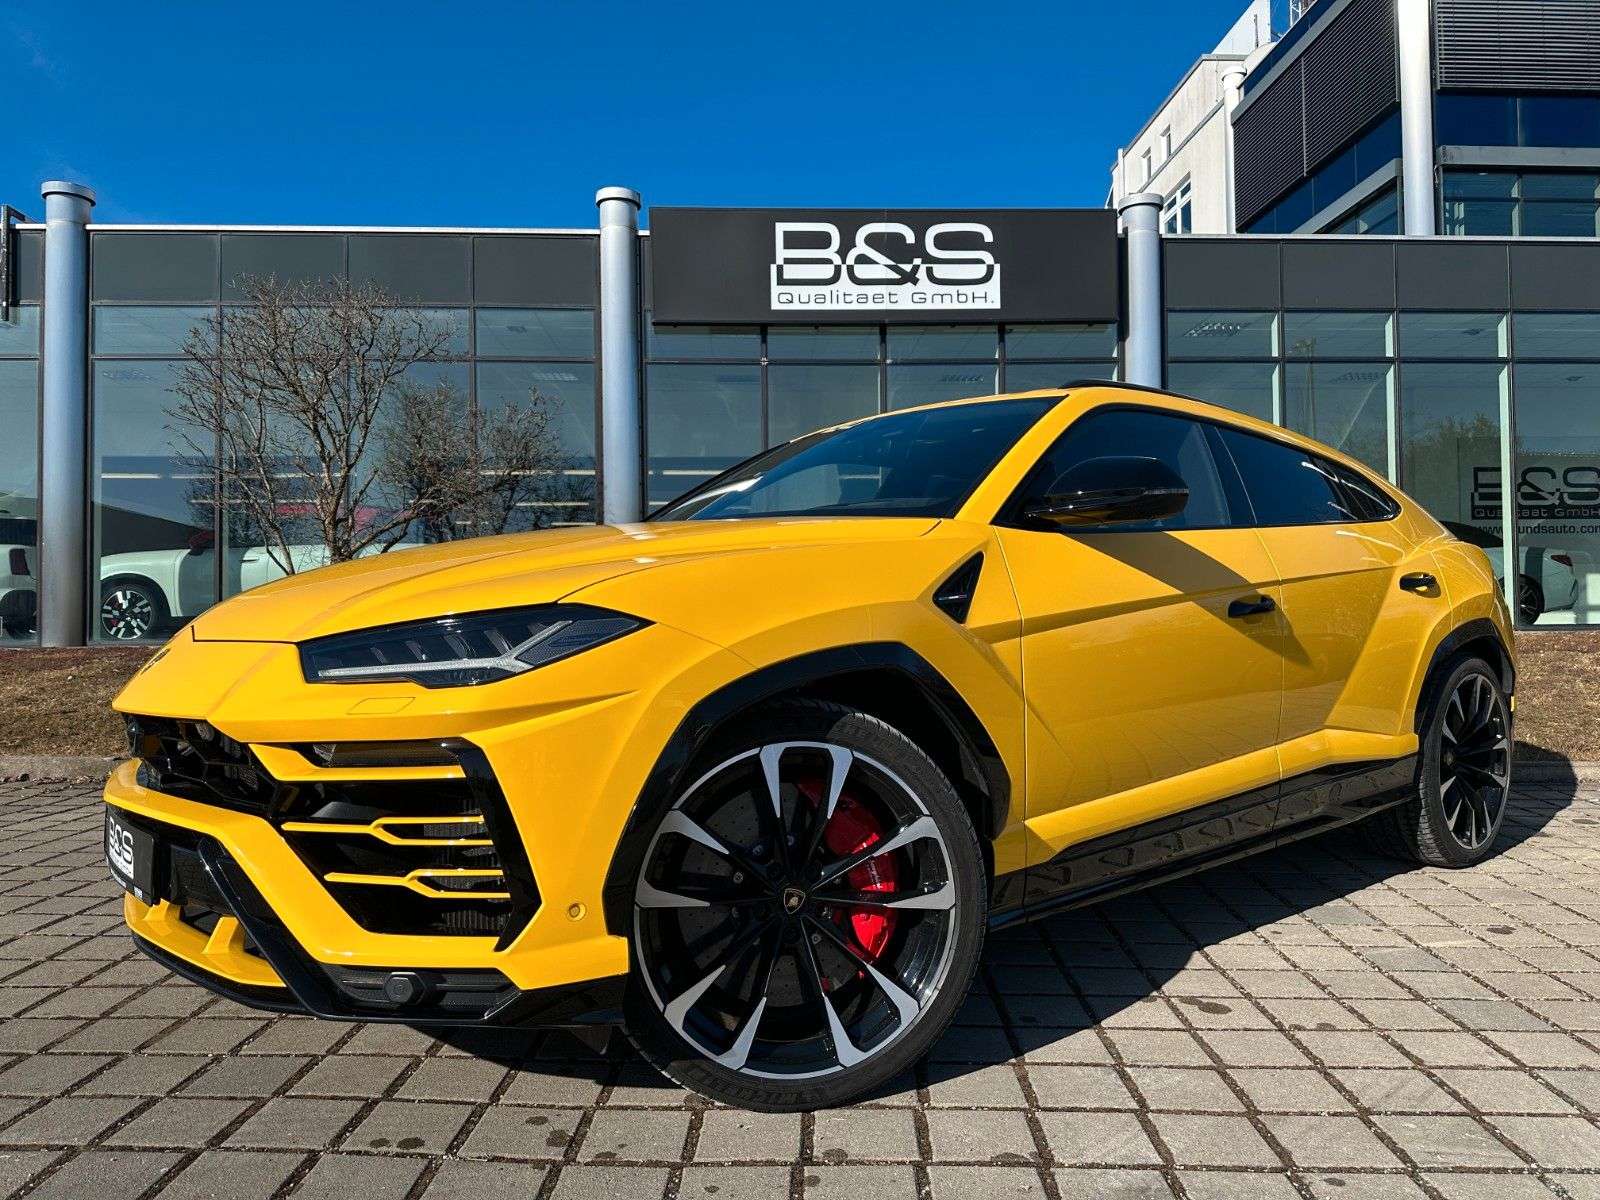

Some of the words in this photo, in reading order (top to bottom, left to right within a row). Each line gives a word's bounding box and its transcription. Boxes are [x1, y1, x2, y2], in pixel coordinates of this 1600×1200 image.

[775, 221, 995, 287] B&S
[777, 290, 899, 305] Qualitaet
[911, 289, 995, 304] GmbH.
[109, 816, 134, 865] B&S
